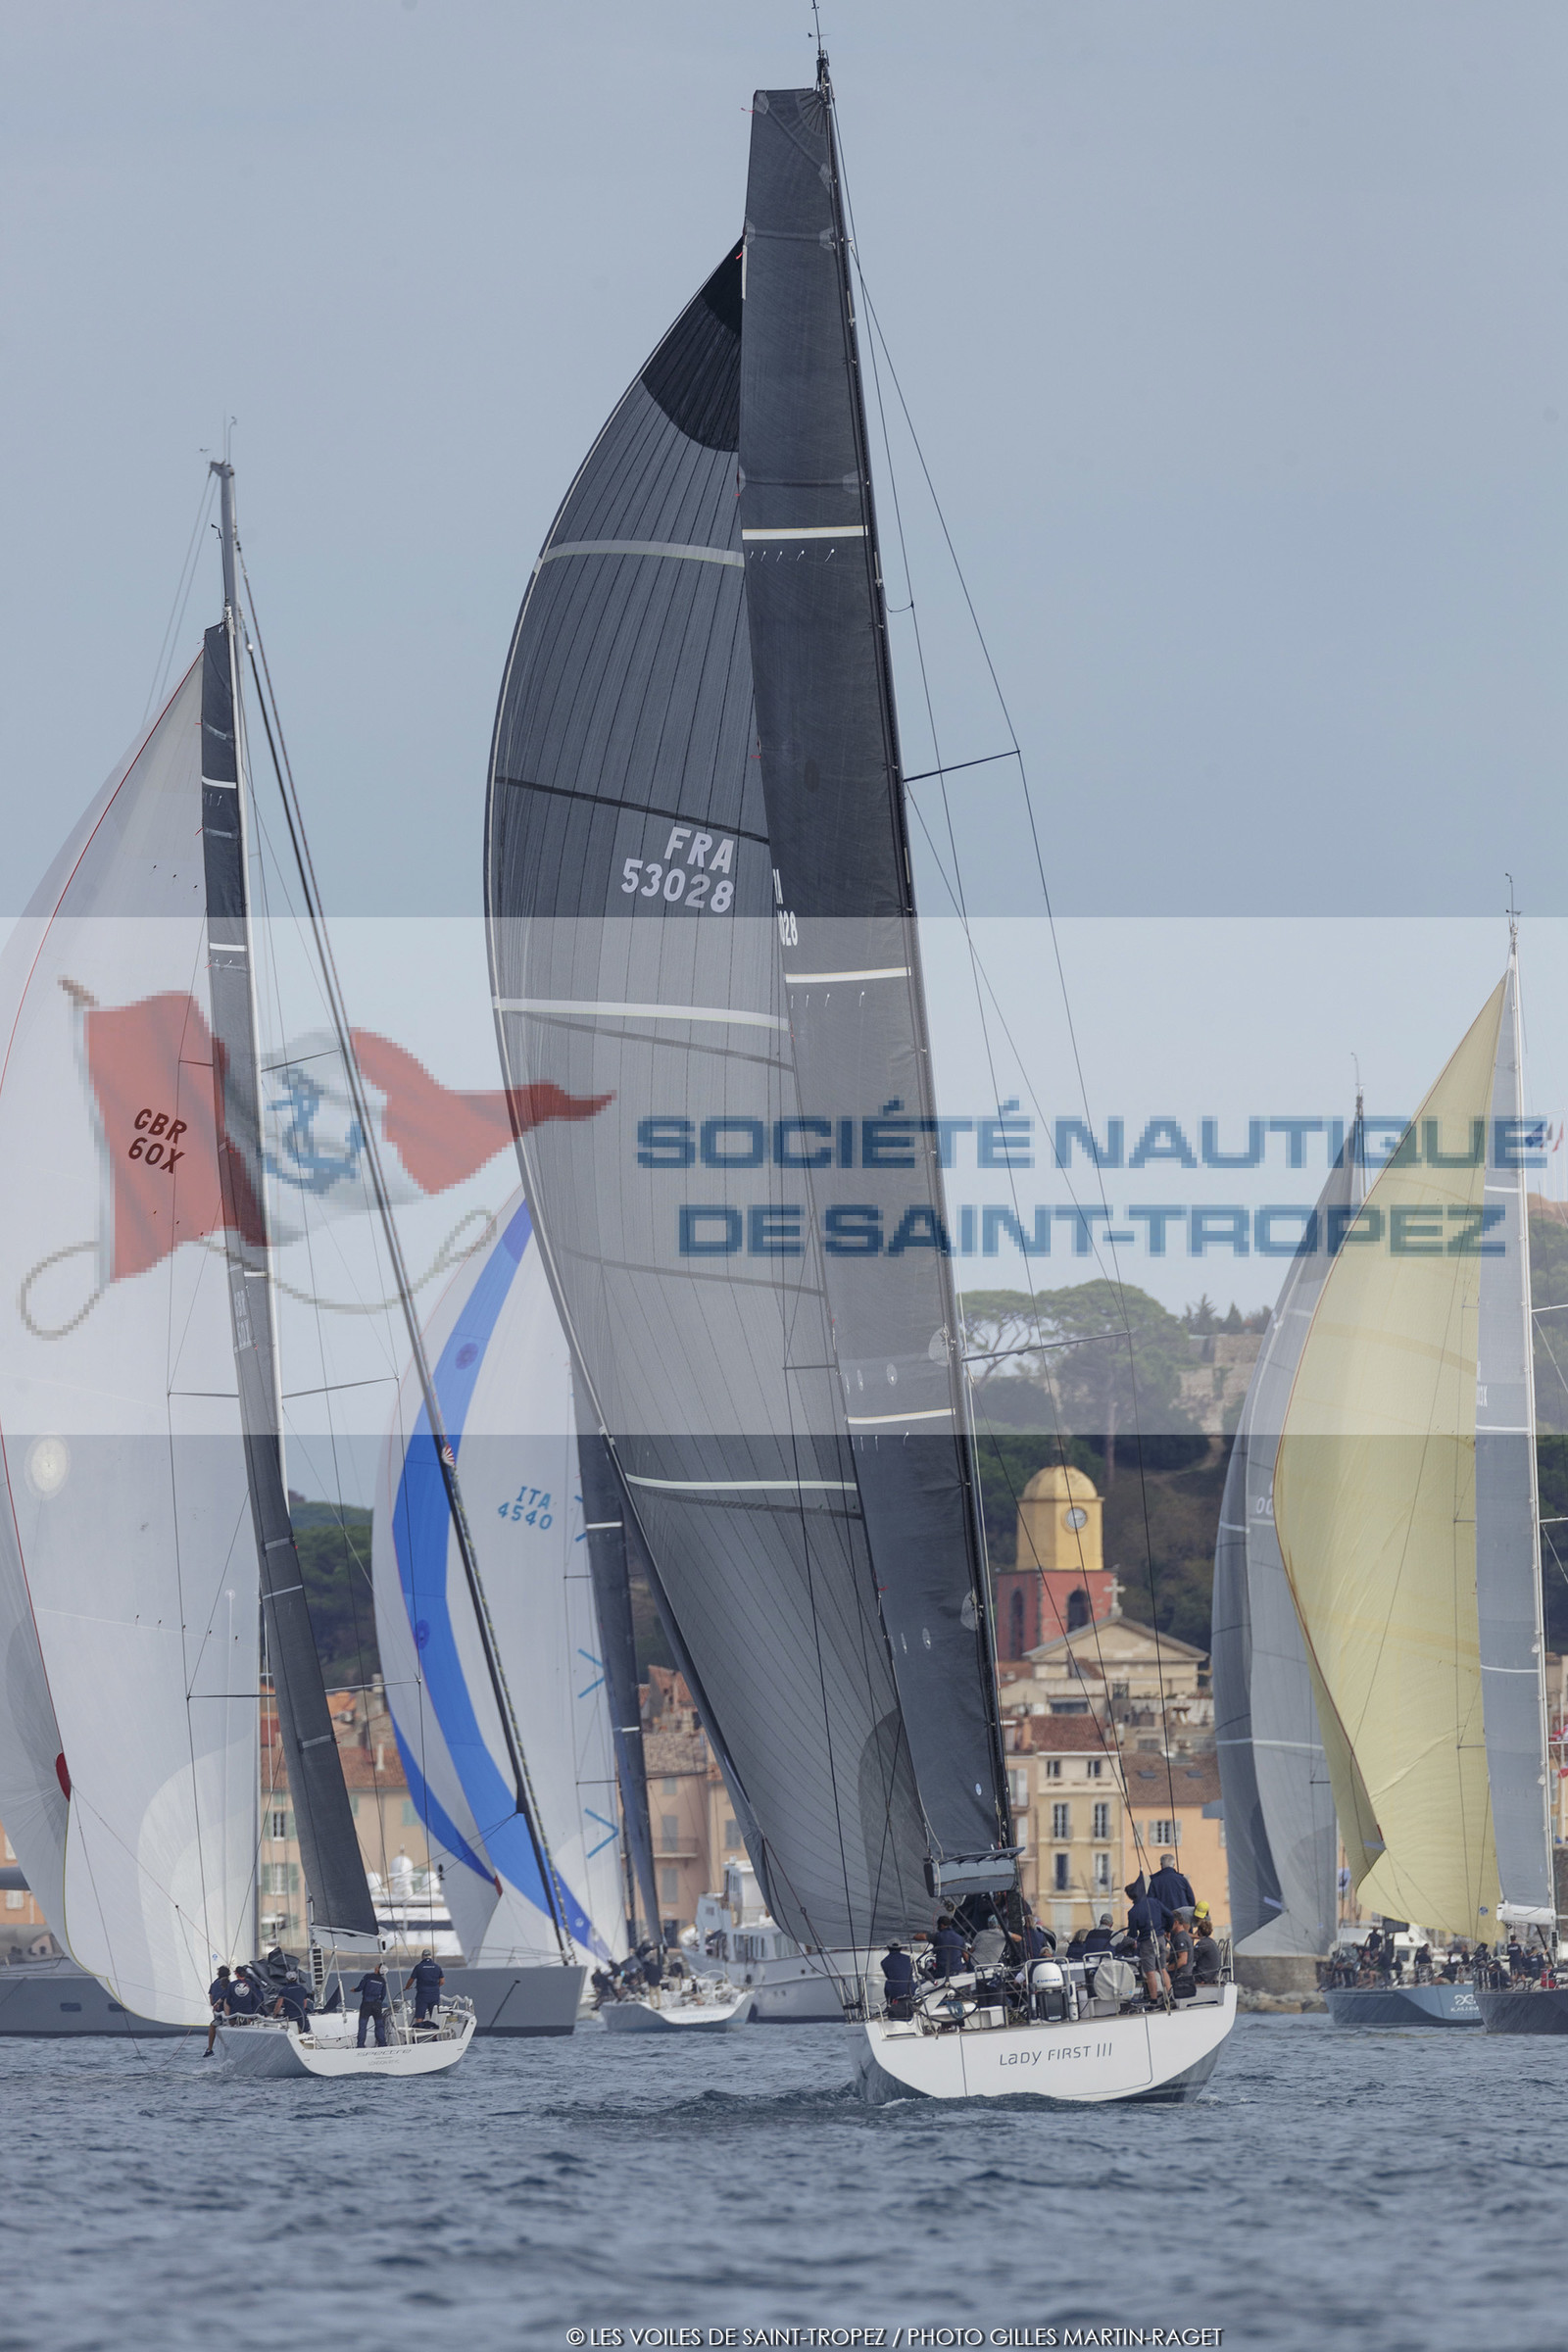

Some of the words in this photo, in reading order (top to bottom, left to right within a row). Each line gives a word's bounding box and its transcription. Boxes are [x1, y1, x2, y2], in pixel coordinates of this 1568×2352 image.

[663, 826, 734, 874] FRA
[620, 858, 734, 913] 53028
[134, 1108, 187, 1145] GBR
[128, 1137, 185, 1174] 60X
[498, 1501, 553, 1530] 4540
[515, 1486, 551, 1510] ITA
[1048, 2045, 1092, 2061] FIRST
[1097, 2041, 1112, 2058] III
